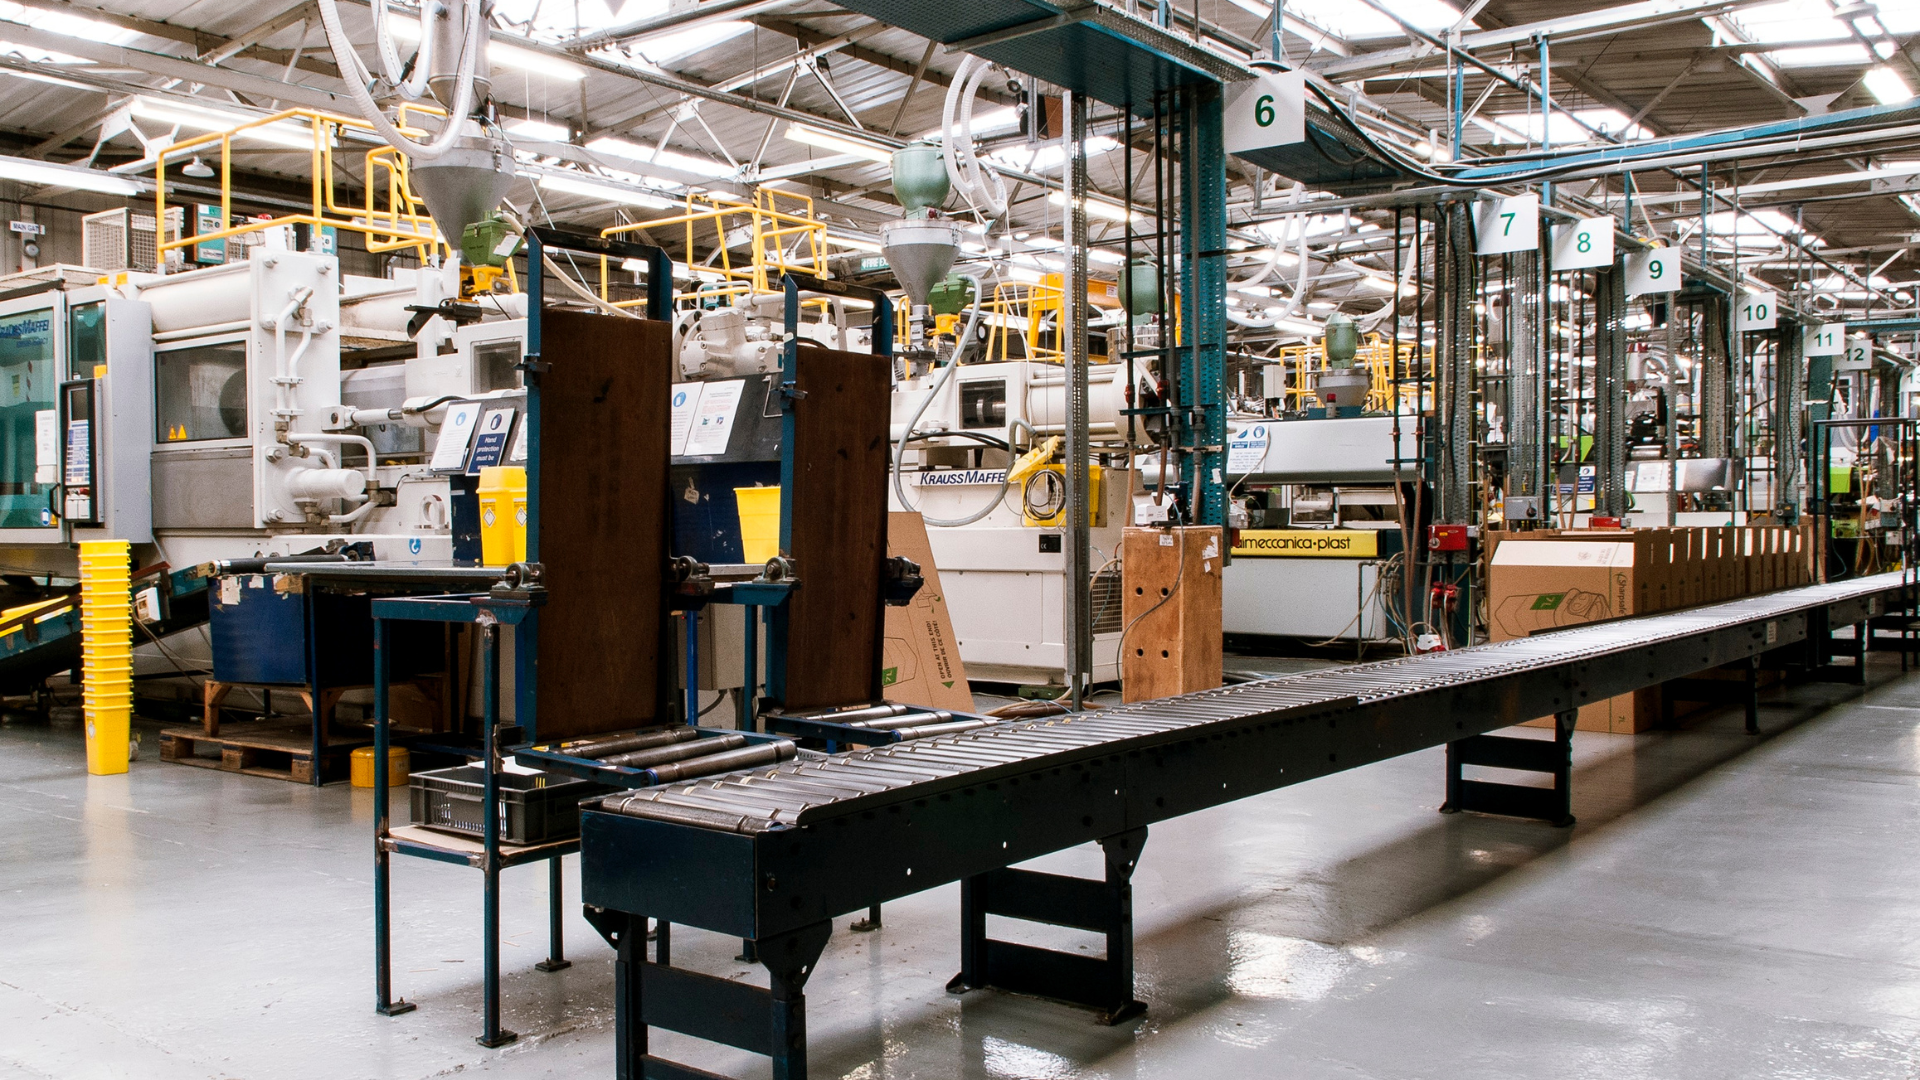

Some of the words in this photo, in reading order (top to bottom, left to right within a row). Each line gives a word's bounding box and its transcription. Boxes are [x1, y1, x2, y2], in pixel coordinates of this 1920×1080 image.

[1254, 94, 1275, 127] 6
[1500, 212, 1515, 236] 7
[1577, 232, 1591, 253] 8
[1649, 260, 1663, 279] 9
[1743, 304, 1767, 321] 10
[1814, 333, 1832, 347] 11
[1844, 348, 1864, 361] 12
[920, 470, 1005, 485] KRAUSSMAFFE
[1540, 596, 1556, 608] 7L
[1618, 580, 1627, 614] Sharpsafe
[926, 621, 934, 636] END!
[930, 637, 938, 651] THIS
[937, 638, 943, 646] CE
[940, 647, 946, 655] DE
[937, 662, 946, 679] OPEN
[942, 656, 952, 679] OUVRIR
